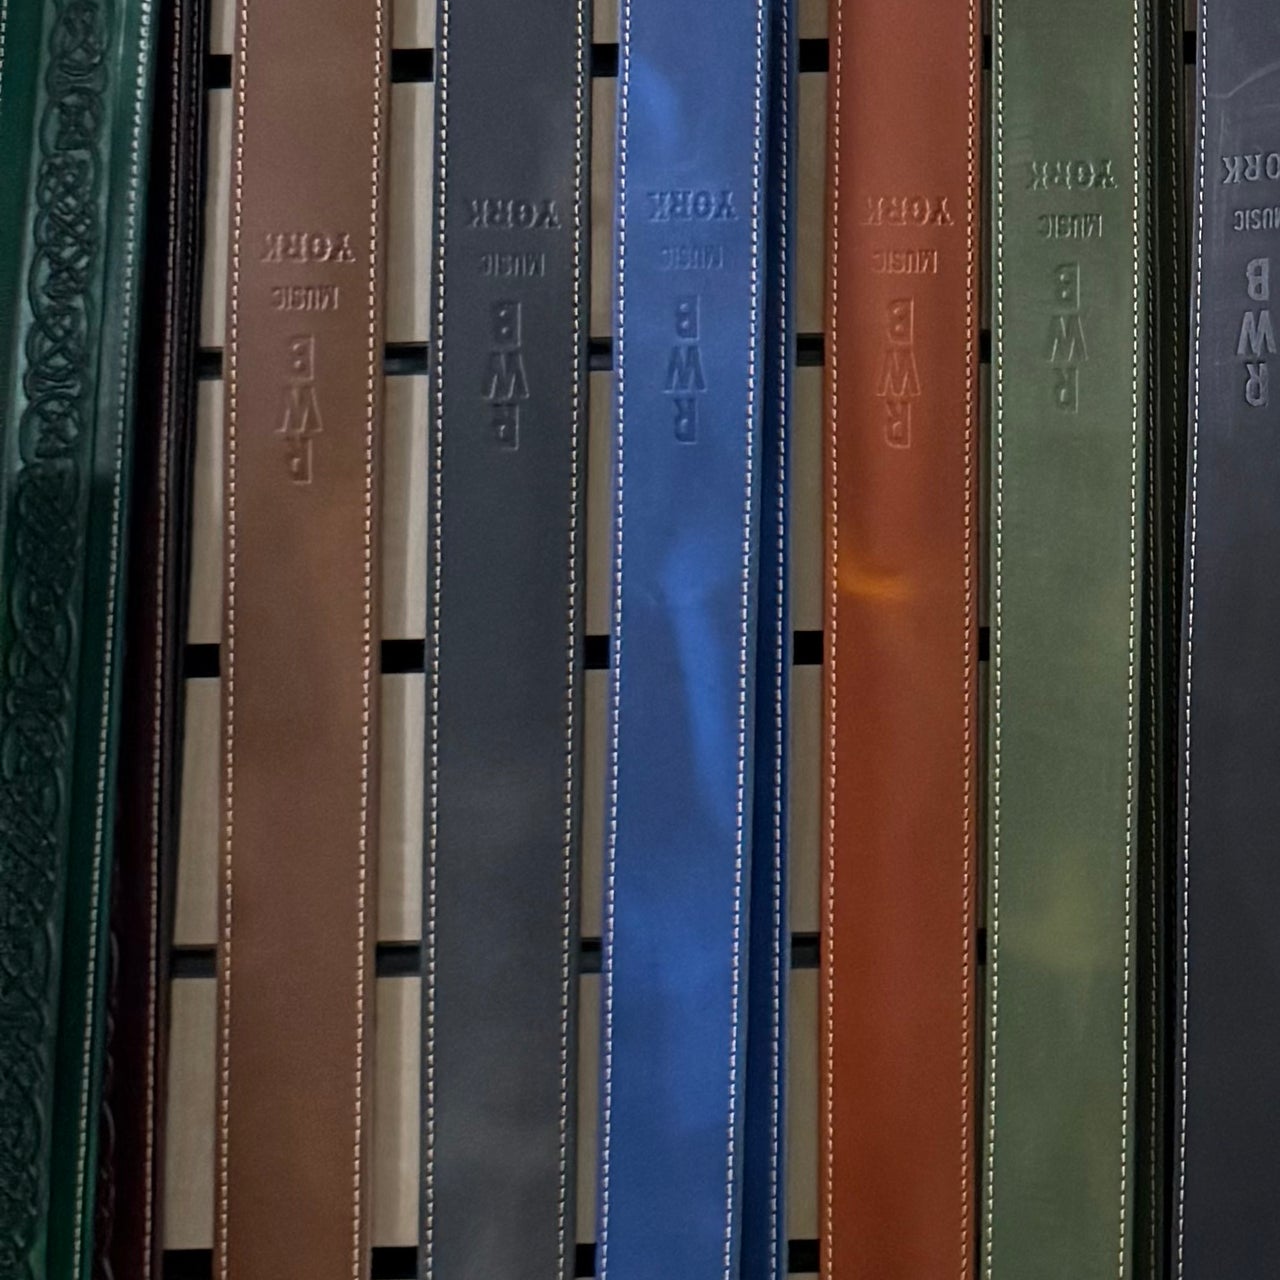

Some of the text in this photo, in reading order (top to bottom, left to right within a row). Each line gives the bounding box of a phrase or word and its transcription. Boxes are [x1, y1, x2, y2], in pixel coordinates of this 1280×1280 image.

[1027, 160, 1117, 191] YORK
[465, 198, 562, 229] YORK
[647, 190, 739, 222] YORK
[860, 197, 955, 226] YORK
[1038, 214, 1103, 239] MUSIC
[260, 232, 356, 263] YORK
[661, 245, 723, 269] MUSIC
[481, 252, 545, 278] MUSIC
[872, 250, 937, 274] MUSIC
[271, 286, 339, 310] MUSIC
